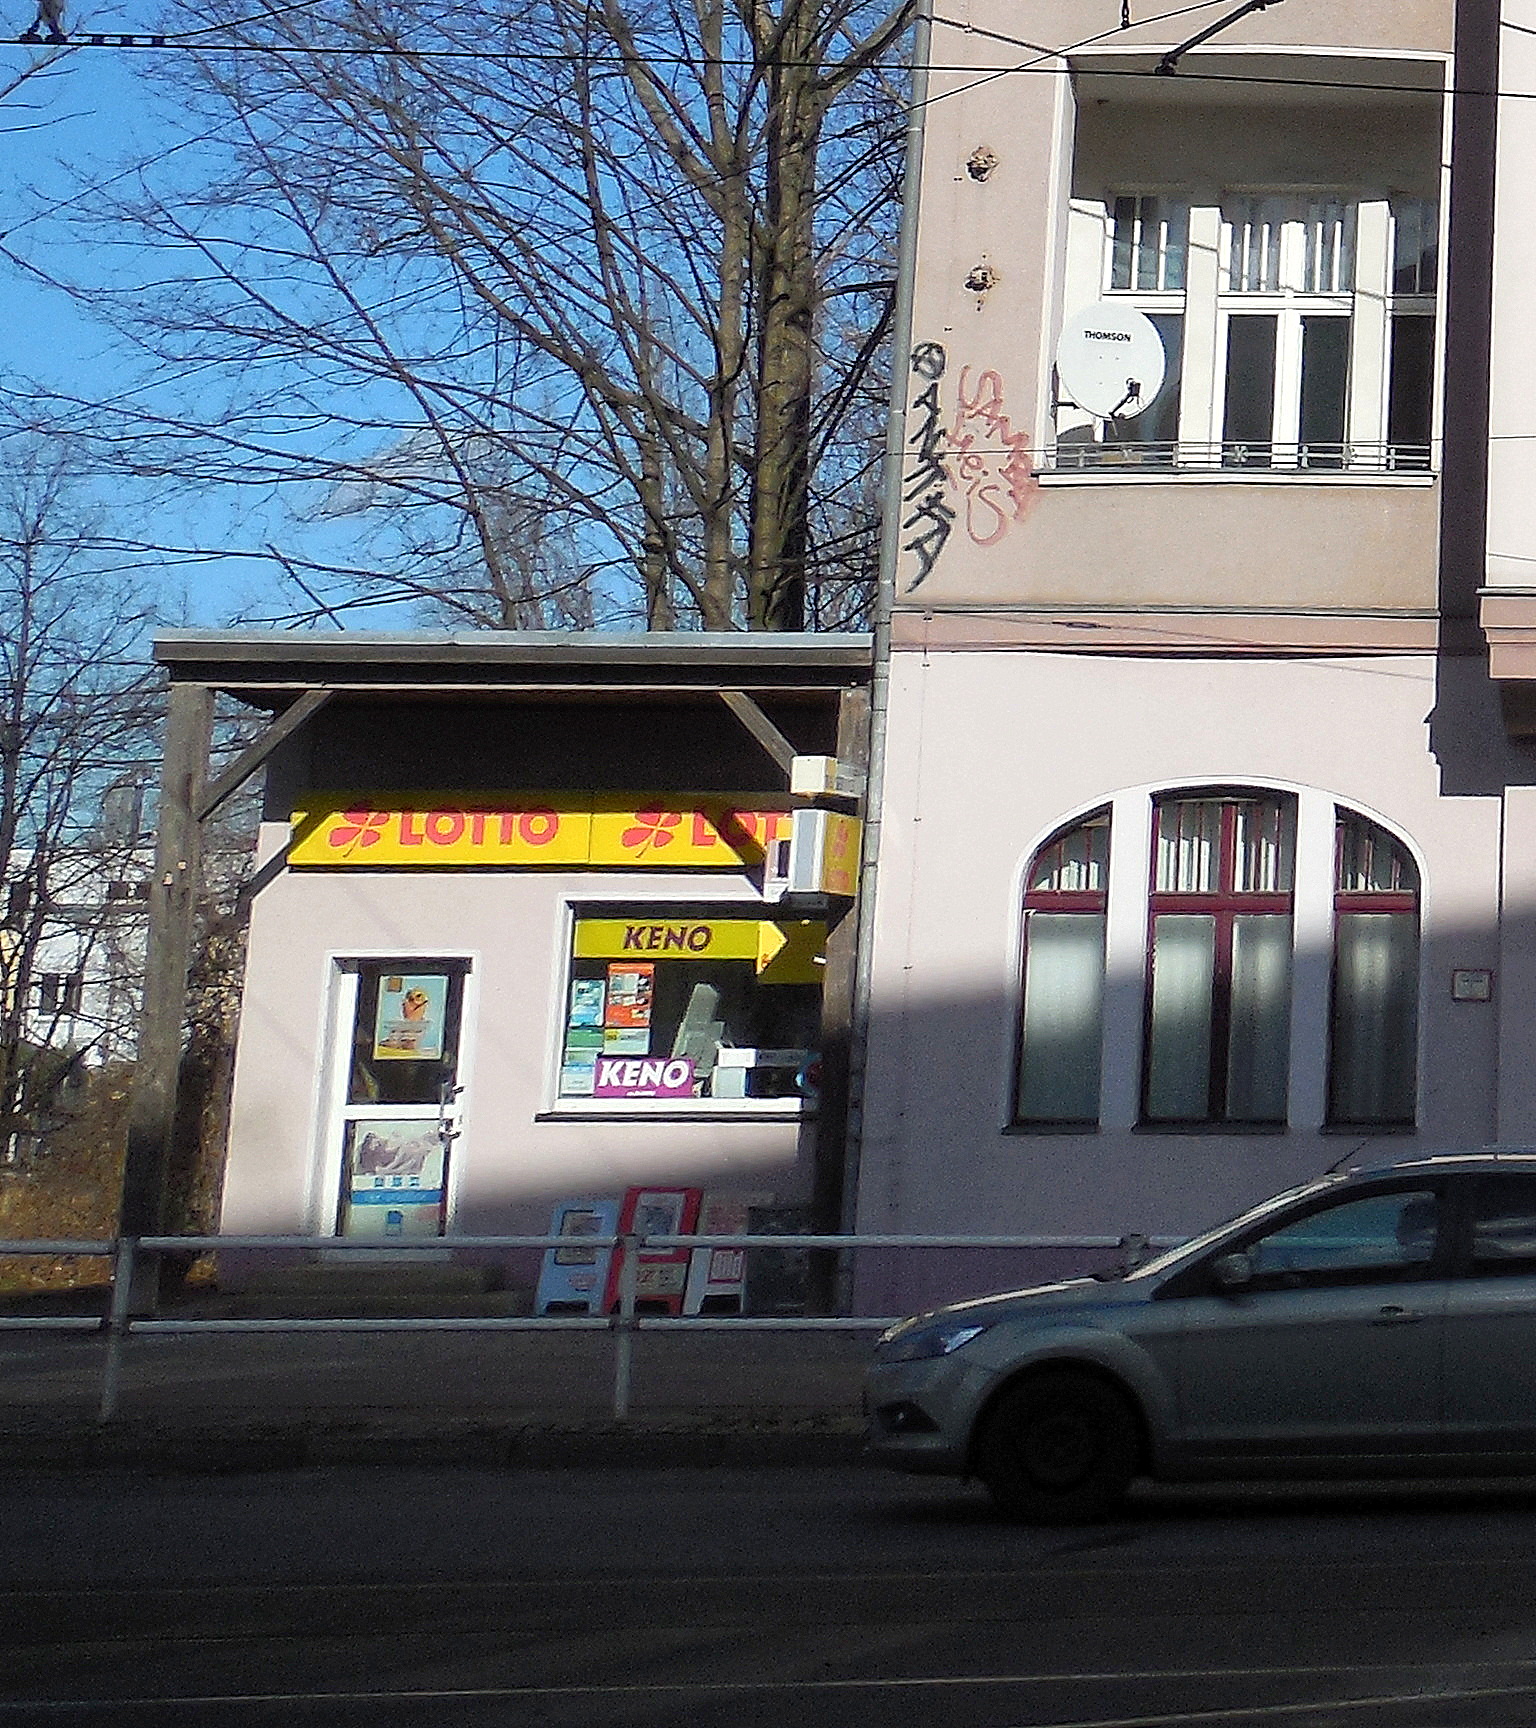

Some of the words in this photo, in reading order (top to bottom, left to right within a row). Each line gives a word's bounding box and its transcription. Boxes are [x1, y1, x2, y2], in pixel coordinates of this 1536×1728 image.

[1083, 329, 1132, 343] THOMSON
[400, 807, 560, 846] LOTTO
[692, 807, 793, 847] LOT
[623, 925, 712, 952] KENO
[598, 1059, 690, 1089] KENO
